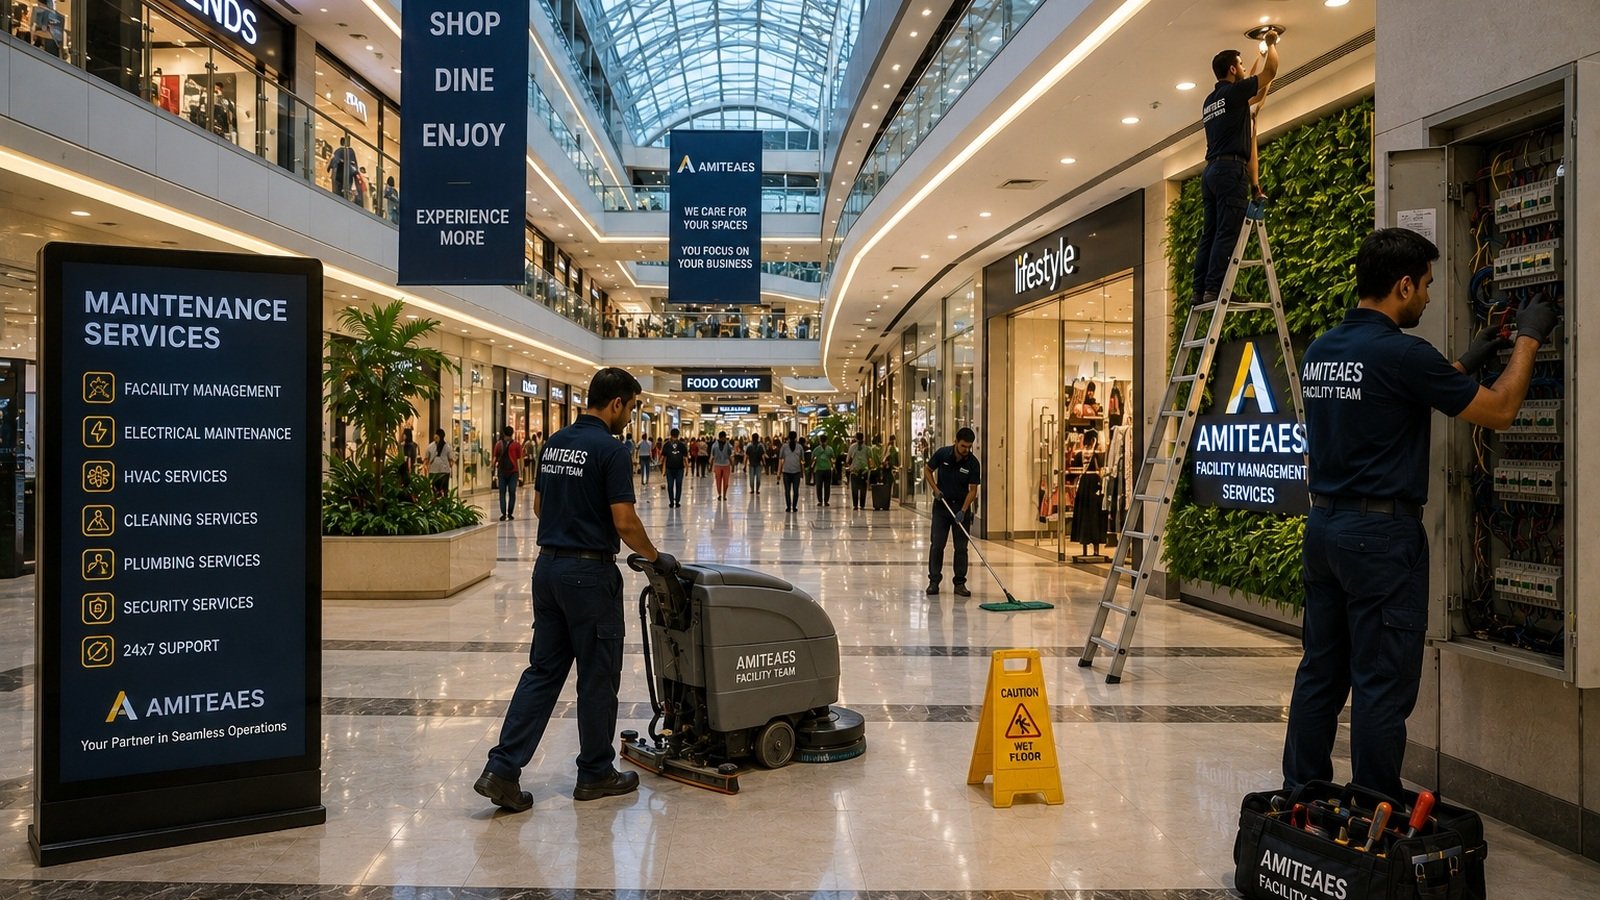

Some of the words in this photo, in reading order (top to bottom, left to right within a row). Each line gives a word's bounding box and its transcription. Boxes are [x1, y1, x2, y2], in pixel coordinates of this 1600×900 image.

[430, 11, 501, 36] SHOP
[435, 67, 494, 92] DINE
[422, 123, 506, 147] ENJOY
[698, 162, 755, 172] AMITEAES
[416, 209, 509, 225] EXPERIENCE
[684, 206, 699, 216] WE
[702, 206, 726, 216] CARE
[728, 207, 747, 216] FOR
[684, 220, 709, 230] YOUR
[712, 220, 748, 230] SPACES
[440, 230, 485, 246] MORE
[682, 246, 700, 255] YOU
[704, 246, 734, 256] FOCUS
[736, 246, 750, 255] ON
[678, 259, 704, 268] YOUR
[706, 259, 753, 269] BUSINESS
[1015, 237, 1074, 294] lifestyle
[84, 290, 288, 322] MAINTENANCE
[84, 322, 221, 350] SERVICES
[1302, 362, 1364, 382] AMITEAES
[193, 384, 282, 398] MANAGEMENT
[687, 378, 718, 388] FOOD
[721, 378, 760, 389] COURT
[1302, 386, 1334, 398] FACILITY
[1336, 386, 1361, 400] TEAM
[124, 426, 200, 440] ELECTRICAL
[204, 427, 292, 440] MAINTENANCE
[1196, 424, 1307, 454] AMITEAES
[542, 448, 588, 465] AMITEAES
[124, 470, 160, 483] HVAC
[165, 470, 227, 483] SERVICES
[1196, 461, 1236, 476] FACILITY
[1238, 462, 1307, 480] MANAGEMENT
[1222, 484, 1275, 504] SERVICES
[124, 514, 192, 527] CLEANING
[196, 512, 258, 525] SERVICES
[124, 557, 195, 570] PLUMBING
[199, 554, 260, 568] SERVICES
[124, 599, 189, 614] SECURITY
[193, 596, 254, 611] SERVICES
[124, 643, 155, 657] 24x7
[159, 639, 220, 655] SUPPORT
[736, 650, 796, 670] AMITEAES
[736, 670, 772, 683] FACILITY
[774, 666, 796, 678] TEAM
[1001, 687, 1039, 698] CAUTION
[146, 689, 265, 717] AMITEAES
[81, 739, 107, 752] Your
[111, 736, 154, 749] Partner
[158, 732, 168, 744] in
[172, 728, 225, 742] Seamless
[228, 722, 287, 737] Operations
[1014, 741, 1034, 750] WET
[1009, 752, 1041, 762] FLOOR
[1260, 849, 1348, 900] AMITEAES
[1260, 874, 1307, 900] FACILITY
